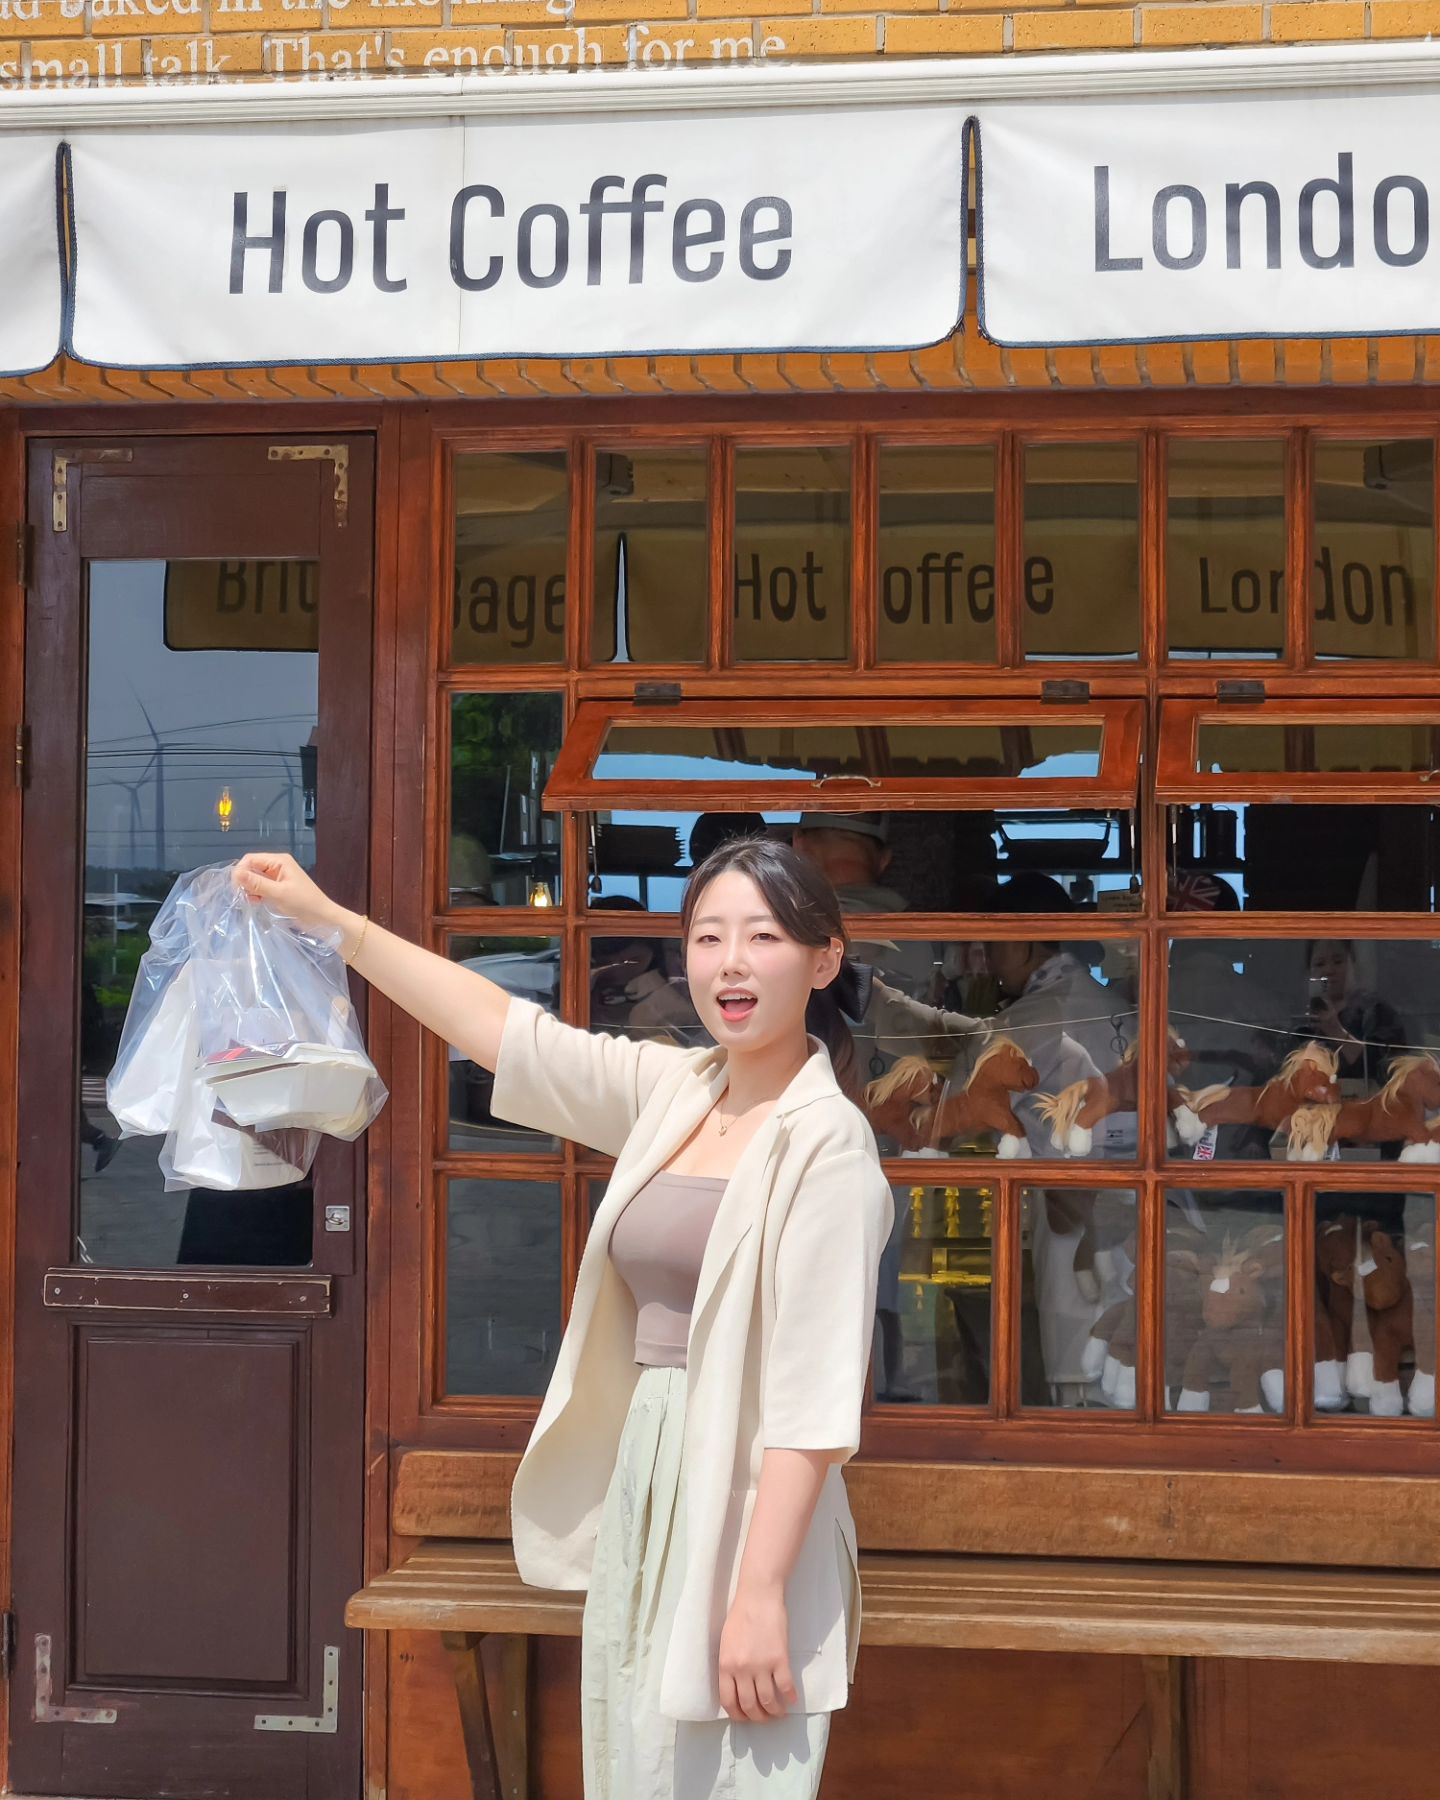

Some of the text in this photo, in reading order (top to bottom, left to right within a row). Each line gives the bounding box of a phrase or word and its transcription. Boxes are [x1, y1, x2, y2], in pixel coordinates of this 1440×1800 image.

[271, 36, 405, 83] That's
[423, 28, 604, 77] enough
[622, 23, 695, 71] for
[229, 173, 793, 294] Hot Coffee
[1094, 152, 1430, 272] Londo
[454, 567, 566, 649] age
[735, 551, 1055, 625] Hot offee
